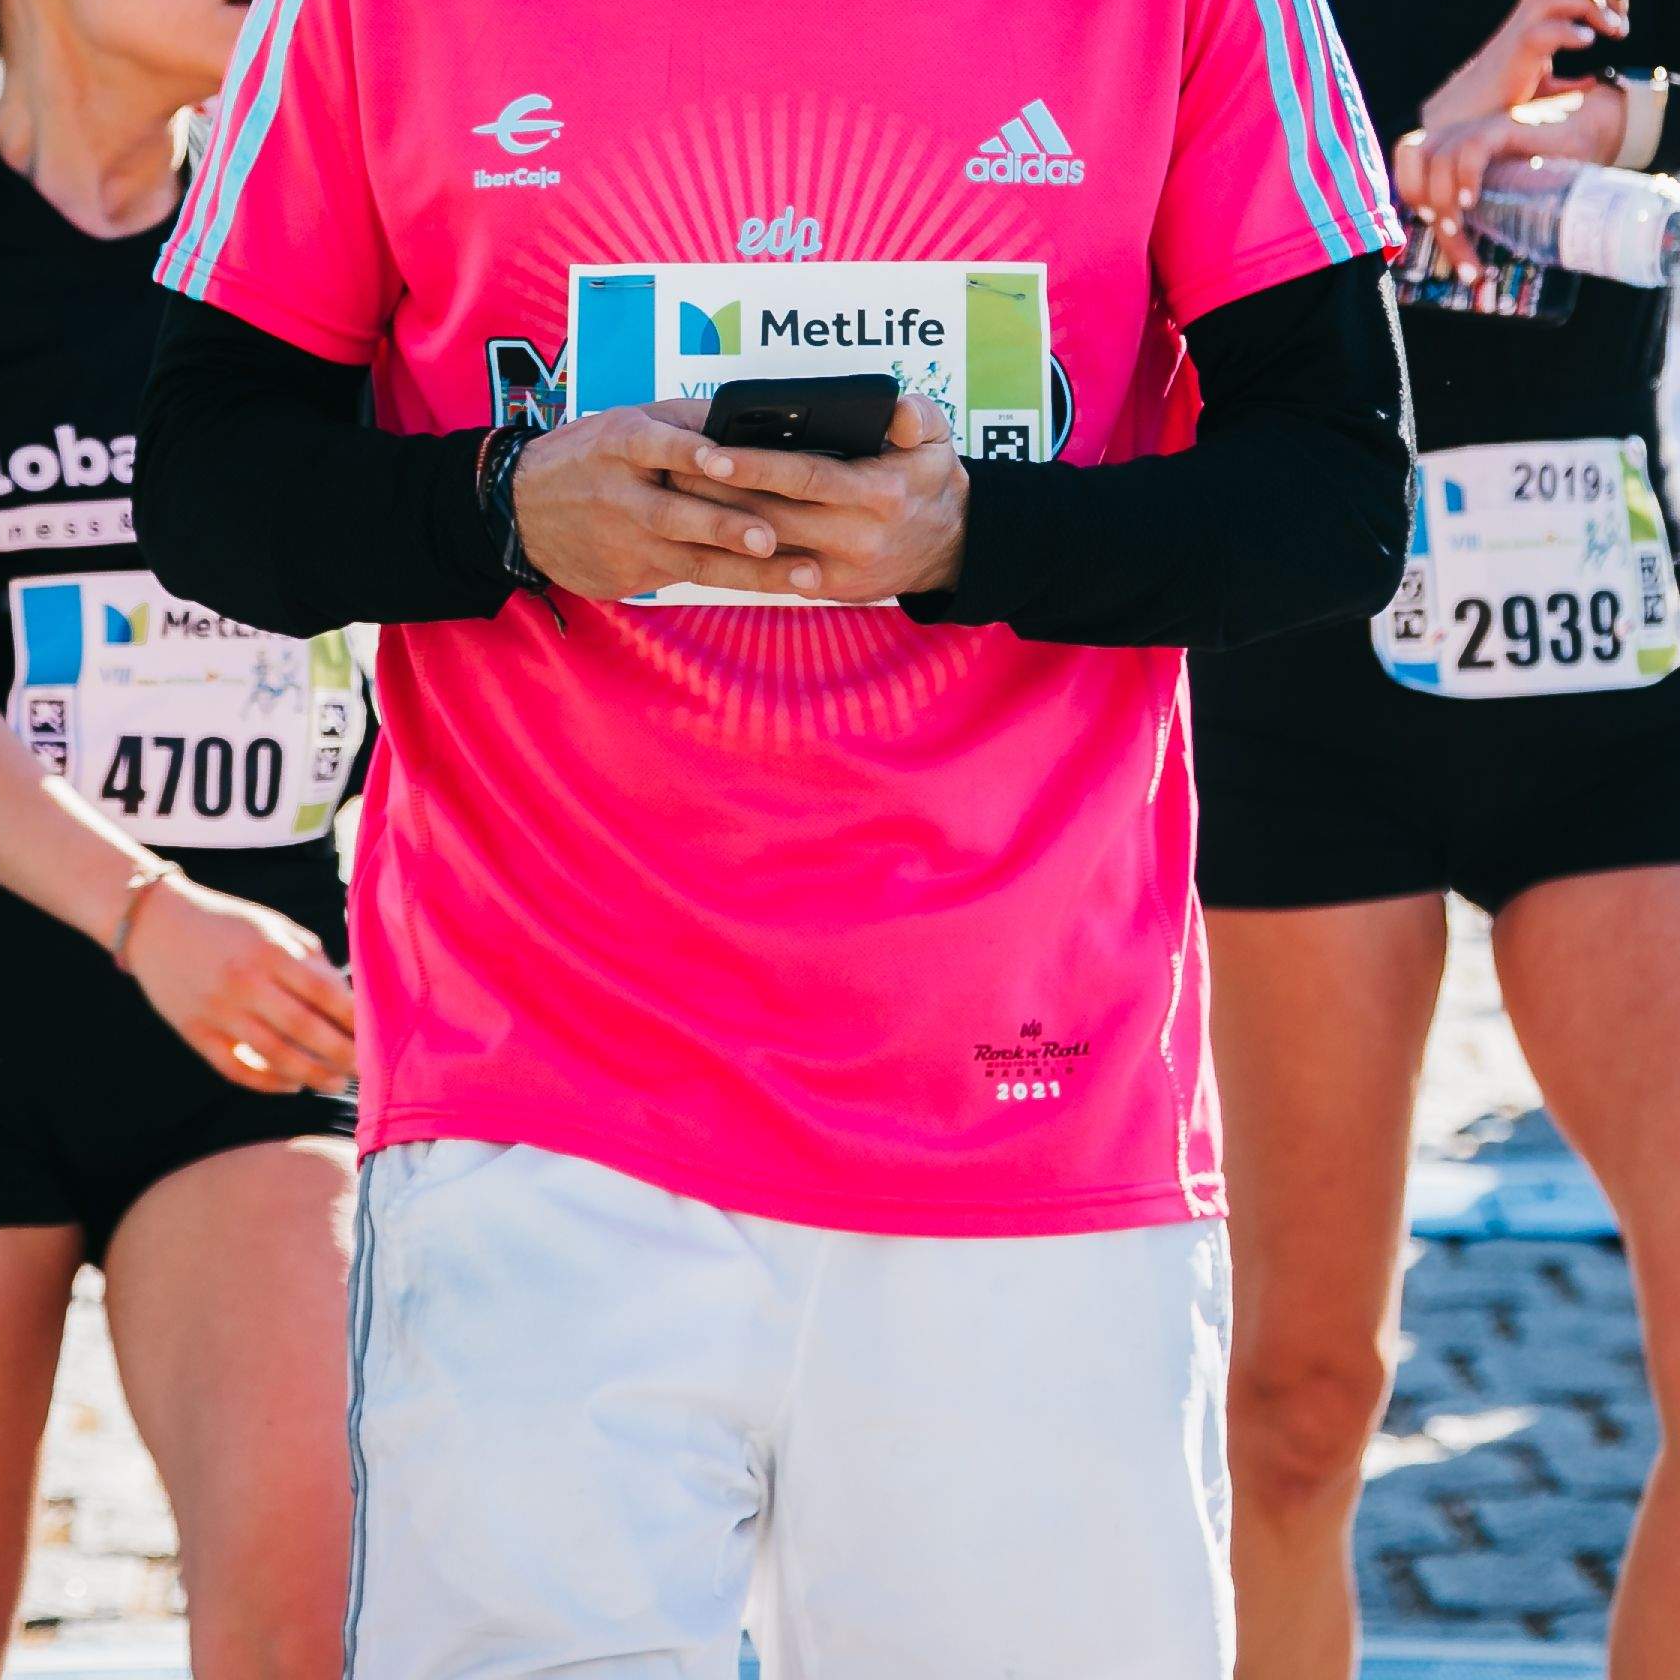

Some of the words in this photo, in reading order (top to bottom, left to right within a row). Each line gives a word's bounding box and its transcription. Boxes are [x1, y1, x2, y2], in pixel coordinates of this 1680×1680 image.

[965, 150, 1086, 186] adidas
[736, 205, 823, 262] edp
[760, 307, 946, 347] MetLife
[1513, 462, 1601, 501] 2019
[1453, 588, 1622, 673] 2939
[100, 733, 285, 819] 4700
[995, 1080, 1062, 1101] 2021
